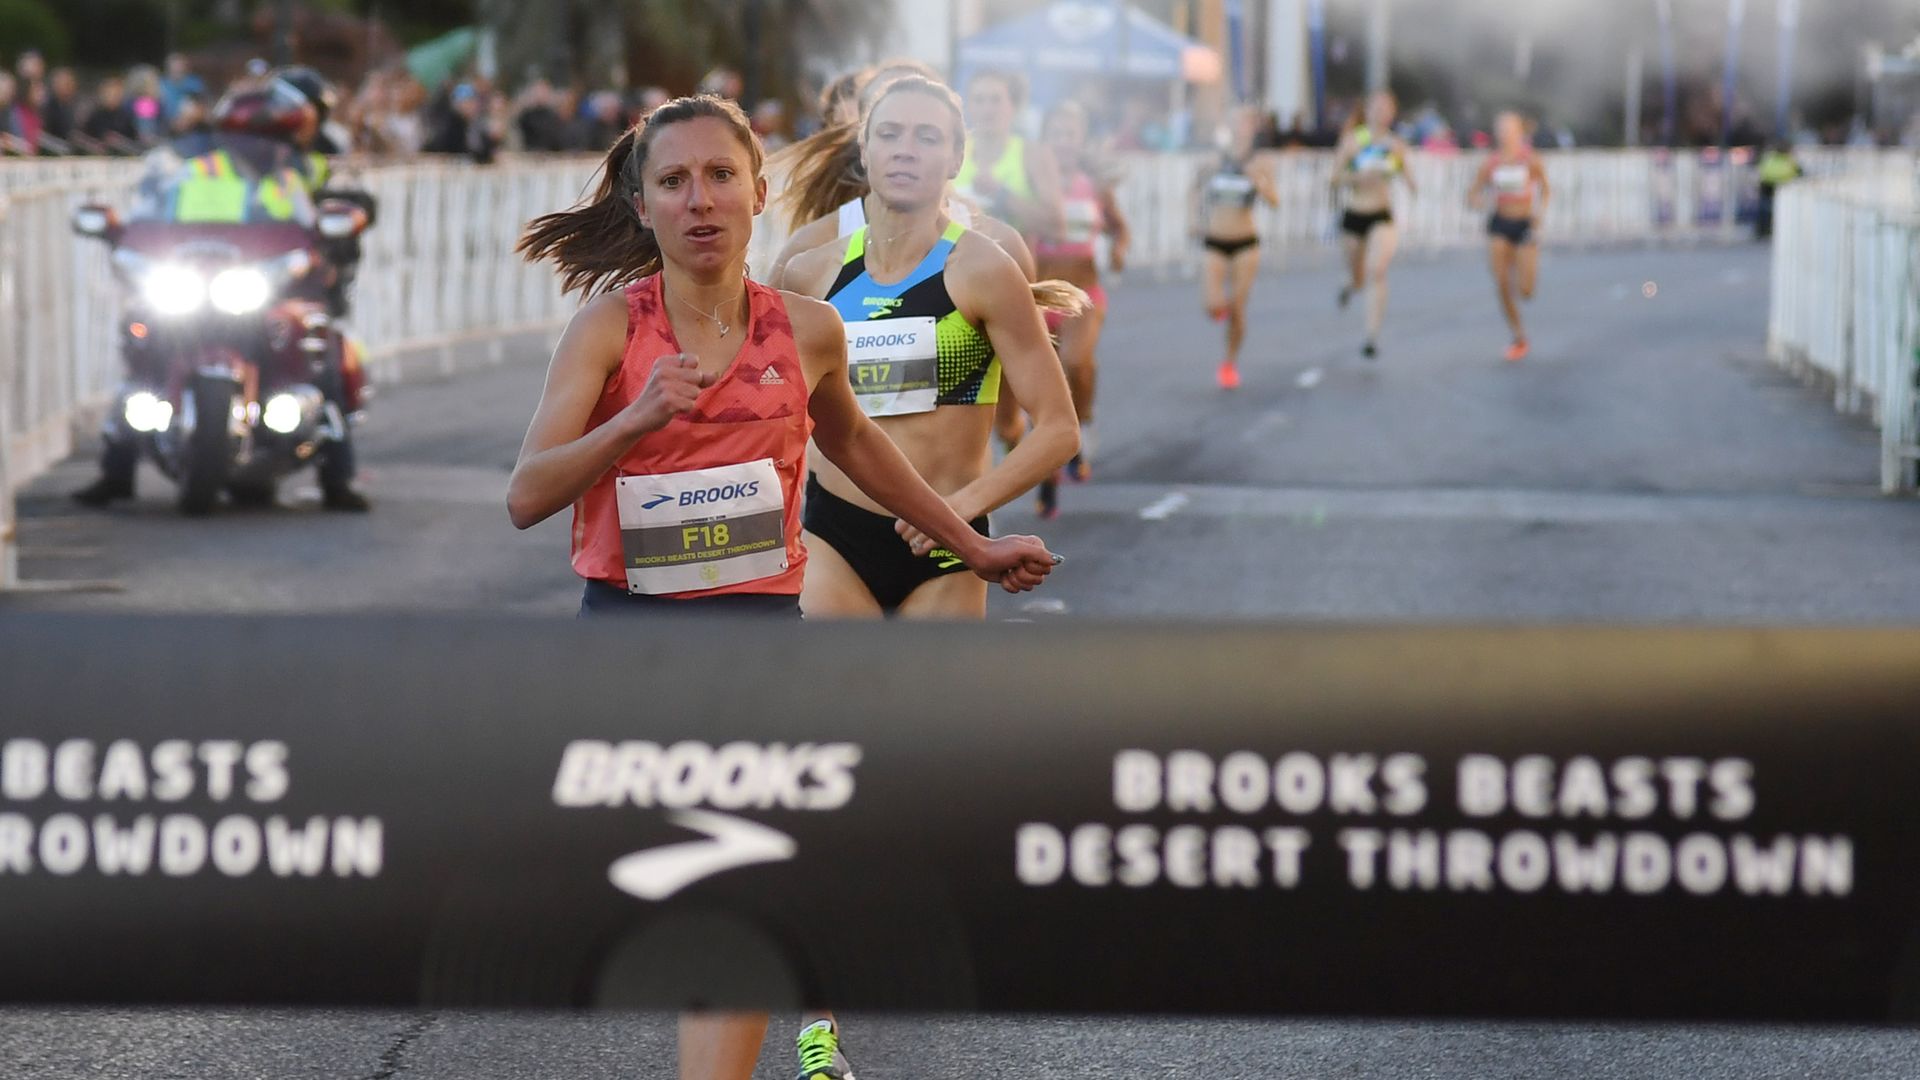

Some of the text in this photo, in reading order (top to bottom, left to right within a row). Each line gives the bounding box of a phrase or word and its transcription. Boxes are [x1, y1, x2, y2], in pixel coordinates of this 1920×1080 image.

[856, 333, 916, 348] BROOKS
[857, 364, 891, 384] F17
[679, 481, 759, 506] BROOKS
[682, 524, 730, 549] F18
[635, 556, 667, 564] BROOKS
[667, 552, 696, 562] BEASTS
[929, 550, 956, 558] BRO
[2, 739, 289, 802] BEASTS
[553, 740, 862, 809] BROOKS
[1114, 750, 1753, 819] BROOKS BEASTS
[1017, 824, 1852, 894] DESERT THROWDOWN
